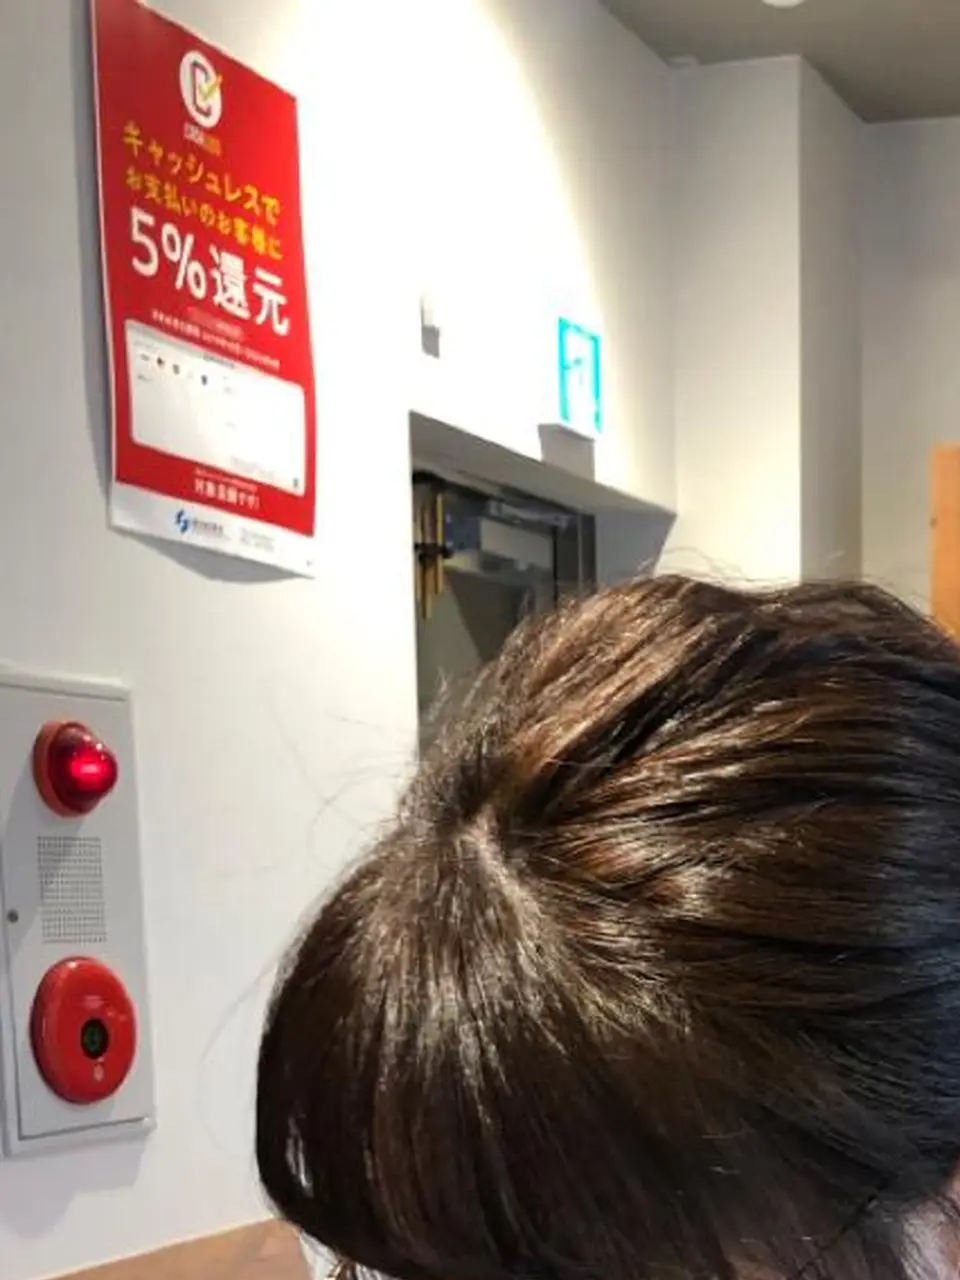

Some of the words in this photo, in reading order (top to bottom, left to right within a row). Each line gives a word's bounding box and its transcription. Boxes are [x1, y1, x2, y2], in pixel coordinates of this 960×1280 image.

[123, 120, 282, 227] キャッシュレスで
[129, 204, 289, 336] 5%還元
